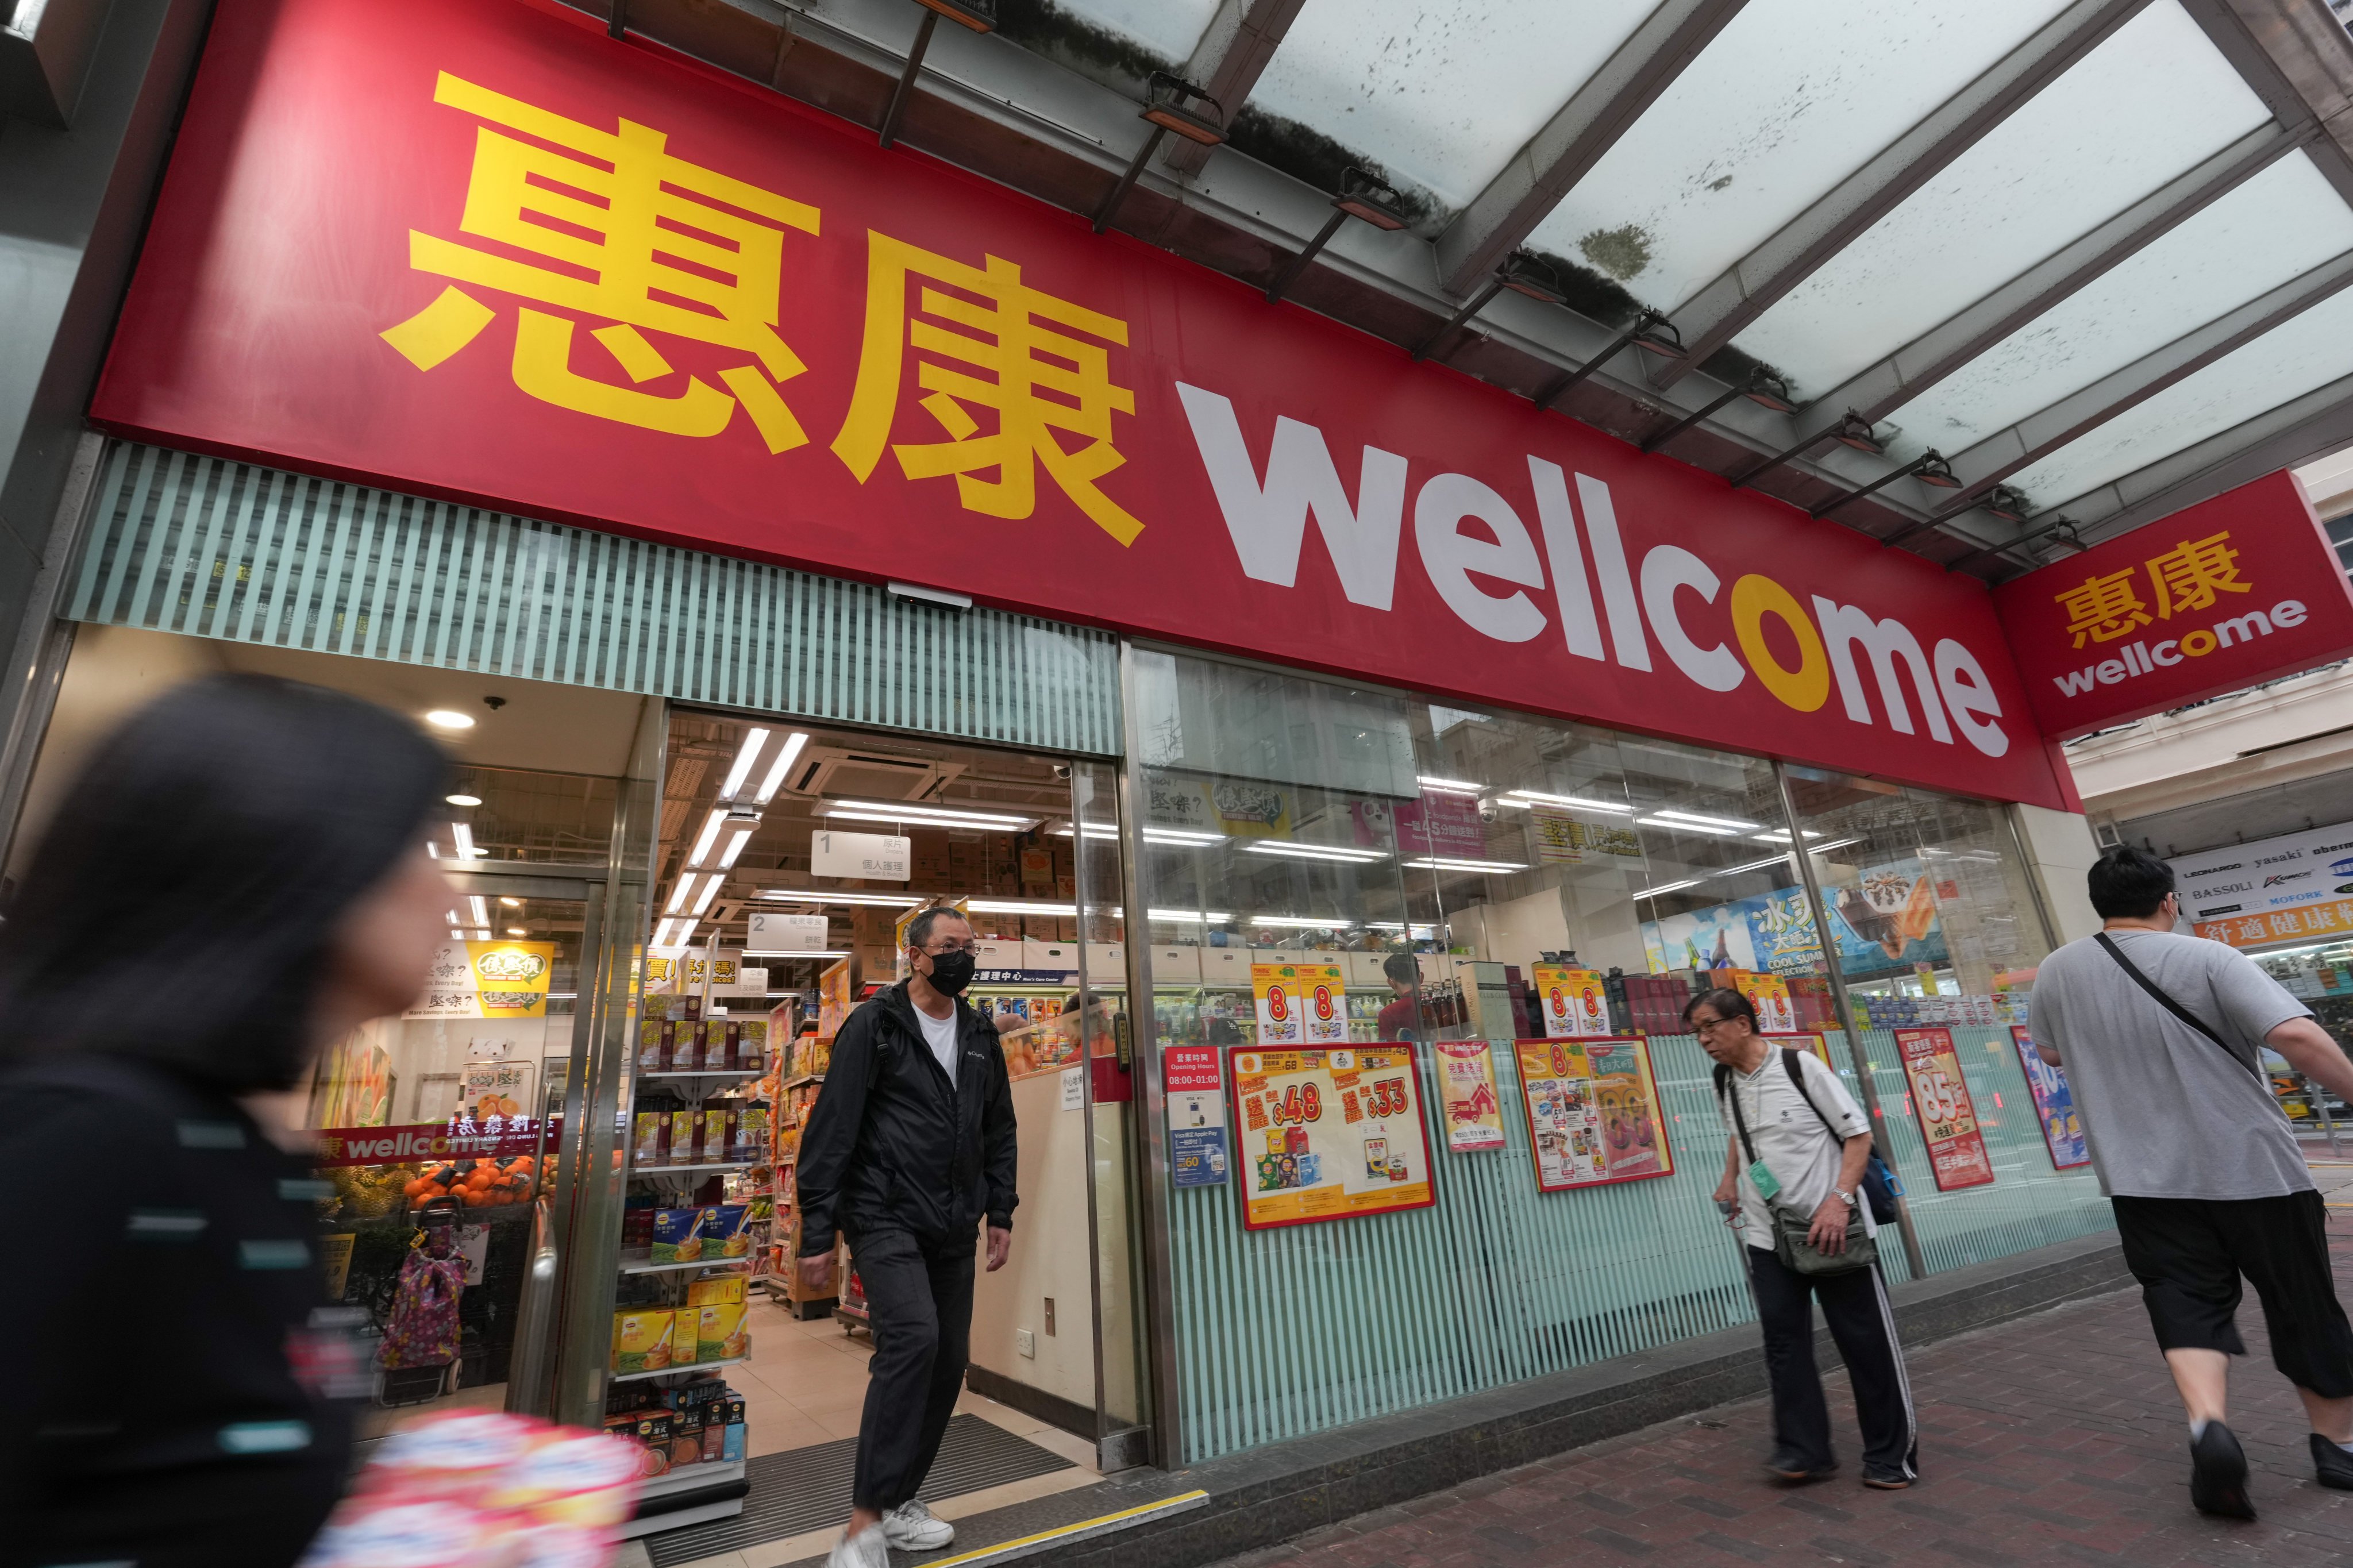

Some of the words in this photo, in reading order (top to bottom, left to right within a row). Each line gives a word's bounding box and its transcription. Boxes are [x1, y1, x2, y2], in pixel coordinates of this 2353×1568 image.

[378, 69, 1146, 548] 惠康
[1175, 380, 2009, 758] wellcome
[2054, 530, 2253, 649] 惠康
[2052, 599, 2308, 698] wellcome
[1247, 814, 1262, 822] VALUE
[820, 834, 830, 853] 1
[883, 838, 903, 849] 尿片
[862, 860, 903, 871] 個人護理
[2184, 863, 2242, 879] LEONARDO
[2254, 849, 2303, 868] yasaki
[2192, 881, 2253, 900] BASSOLI
[2269, 890, 2324, 906] MOFORK
[753, 916, 765, 931] 2
[790, 917, 822, 926] 糖果零食
[805, 935, 822, 944] 餅乾
[1767, 957, 1795, 970] COOL
[1796, 947, 1843, 965] SUMMR
[1772, 965, 1814, 978] SELECTION
[1267, 985, 1288, 1022] 8
[1314, 985, 1334, 1021] 8
[1550, 987, 1566, 1018] 8
[1582, 987, 1599, 1018] 8
[1747, 989, 1762, 1016] 8
[1772, 989, 1786, 1016] 8
[1227, 1021, 1237, 1030] LA
[1176, 1053, 1208, 1062] 營業時間
[1447, 1061, 1484, 1074] 免費送貨
[1549, 1043, 1569, 1077] 8
[1169, 1075, 1218, 1085] 08:00-01:00
[1245, 1095, 1265, 1119] 送
[1273, 1081, 1322, 1127] $48
[1342, 1090, 1360, 1113] 送
[1368, 1076, 1408, 1119] $33
[1916, 1071, 1959, 1124] 85
[1248, 1115, 1269, 1131] FREE
[1345, 1109, 1364, 1124] FREE
[347, 1132, 498, 1159] wellcome
[1185, 1156, 1199, 1167] 60
